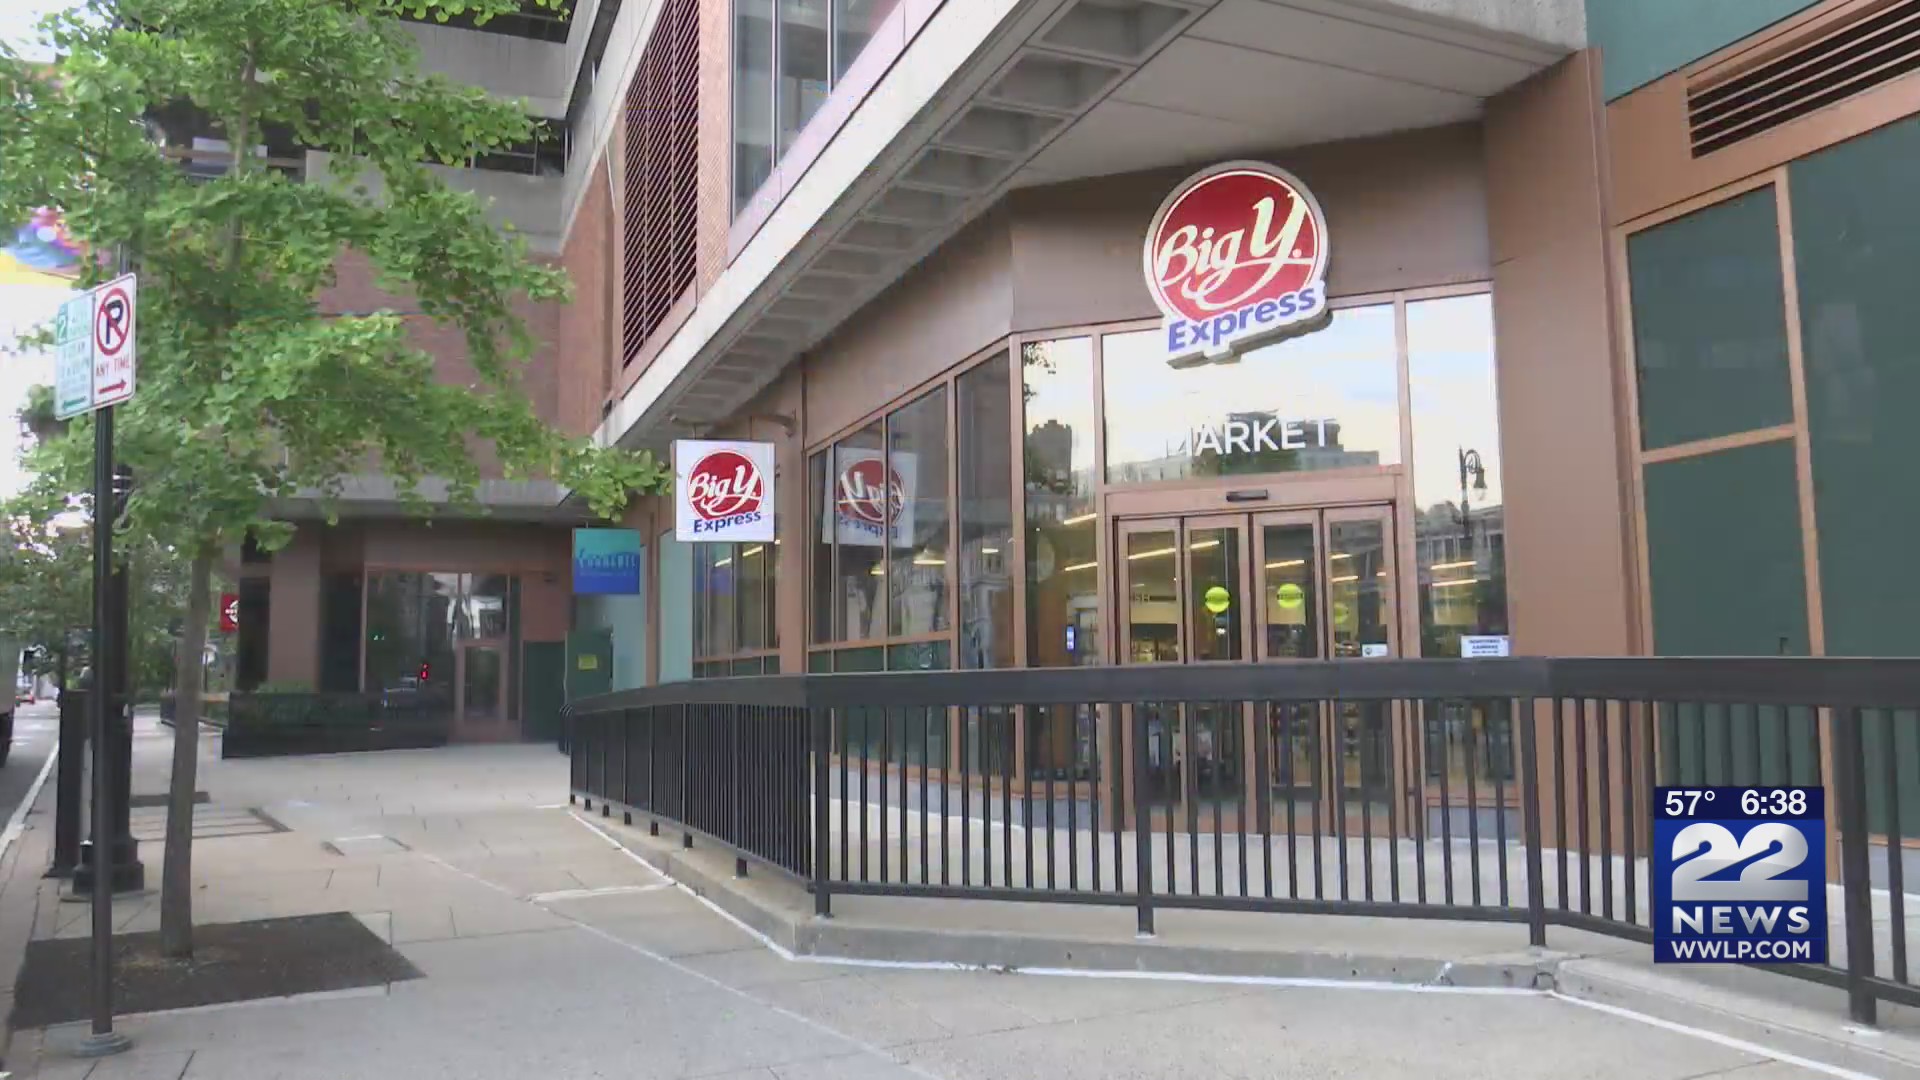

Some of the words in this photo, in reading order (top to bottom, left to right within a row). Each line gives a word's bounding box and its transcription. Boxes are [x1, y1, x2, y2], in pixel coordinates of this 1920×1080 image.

[1158, 224, 1245, 300] Big
[1168, 287, 1317, 352] Express
[96, 360, 110, 377] ANY
[114, 353, 130, 373] TIME
[689, 472, 732, 508] Big
[693, 512, 762, 533] Express
